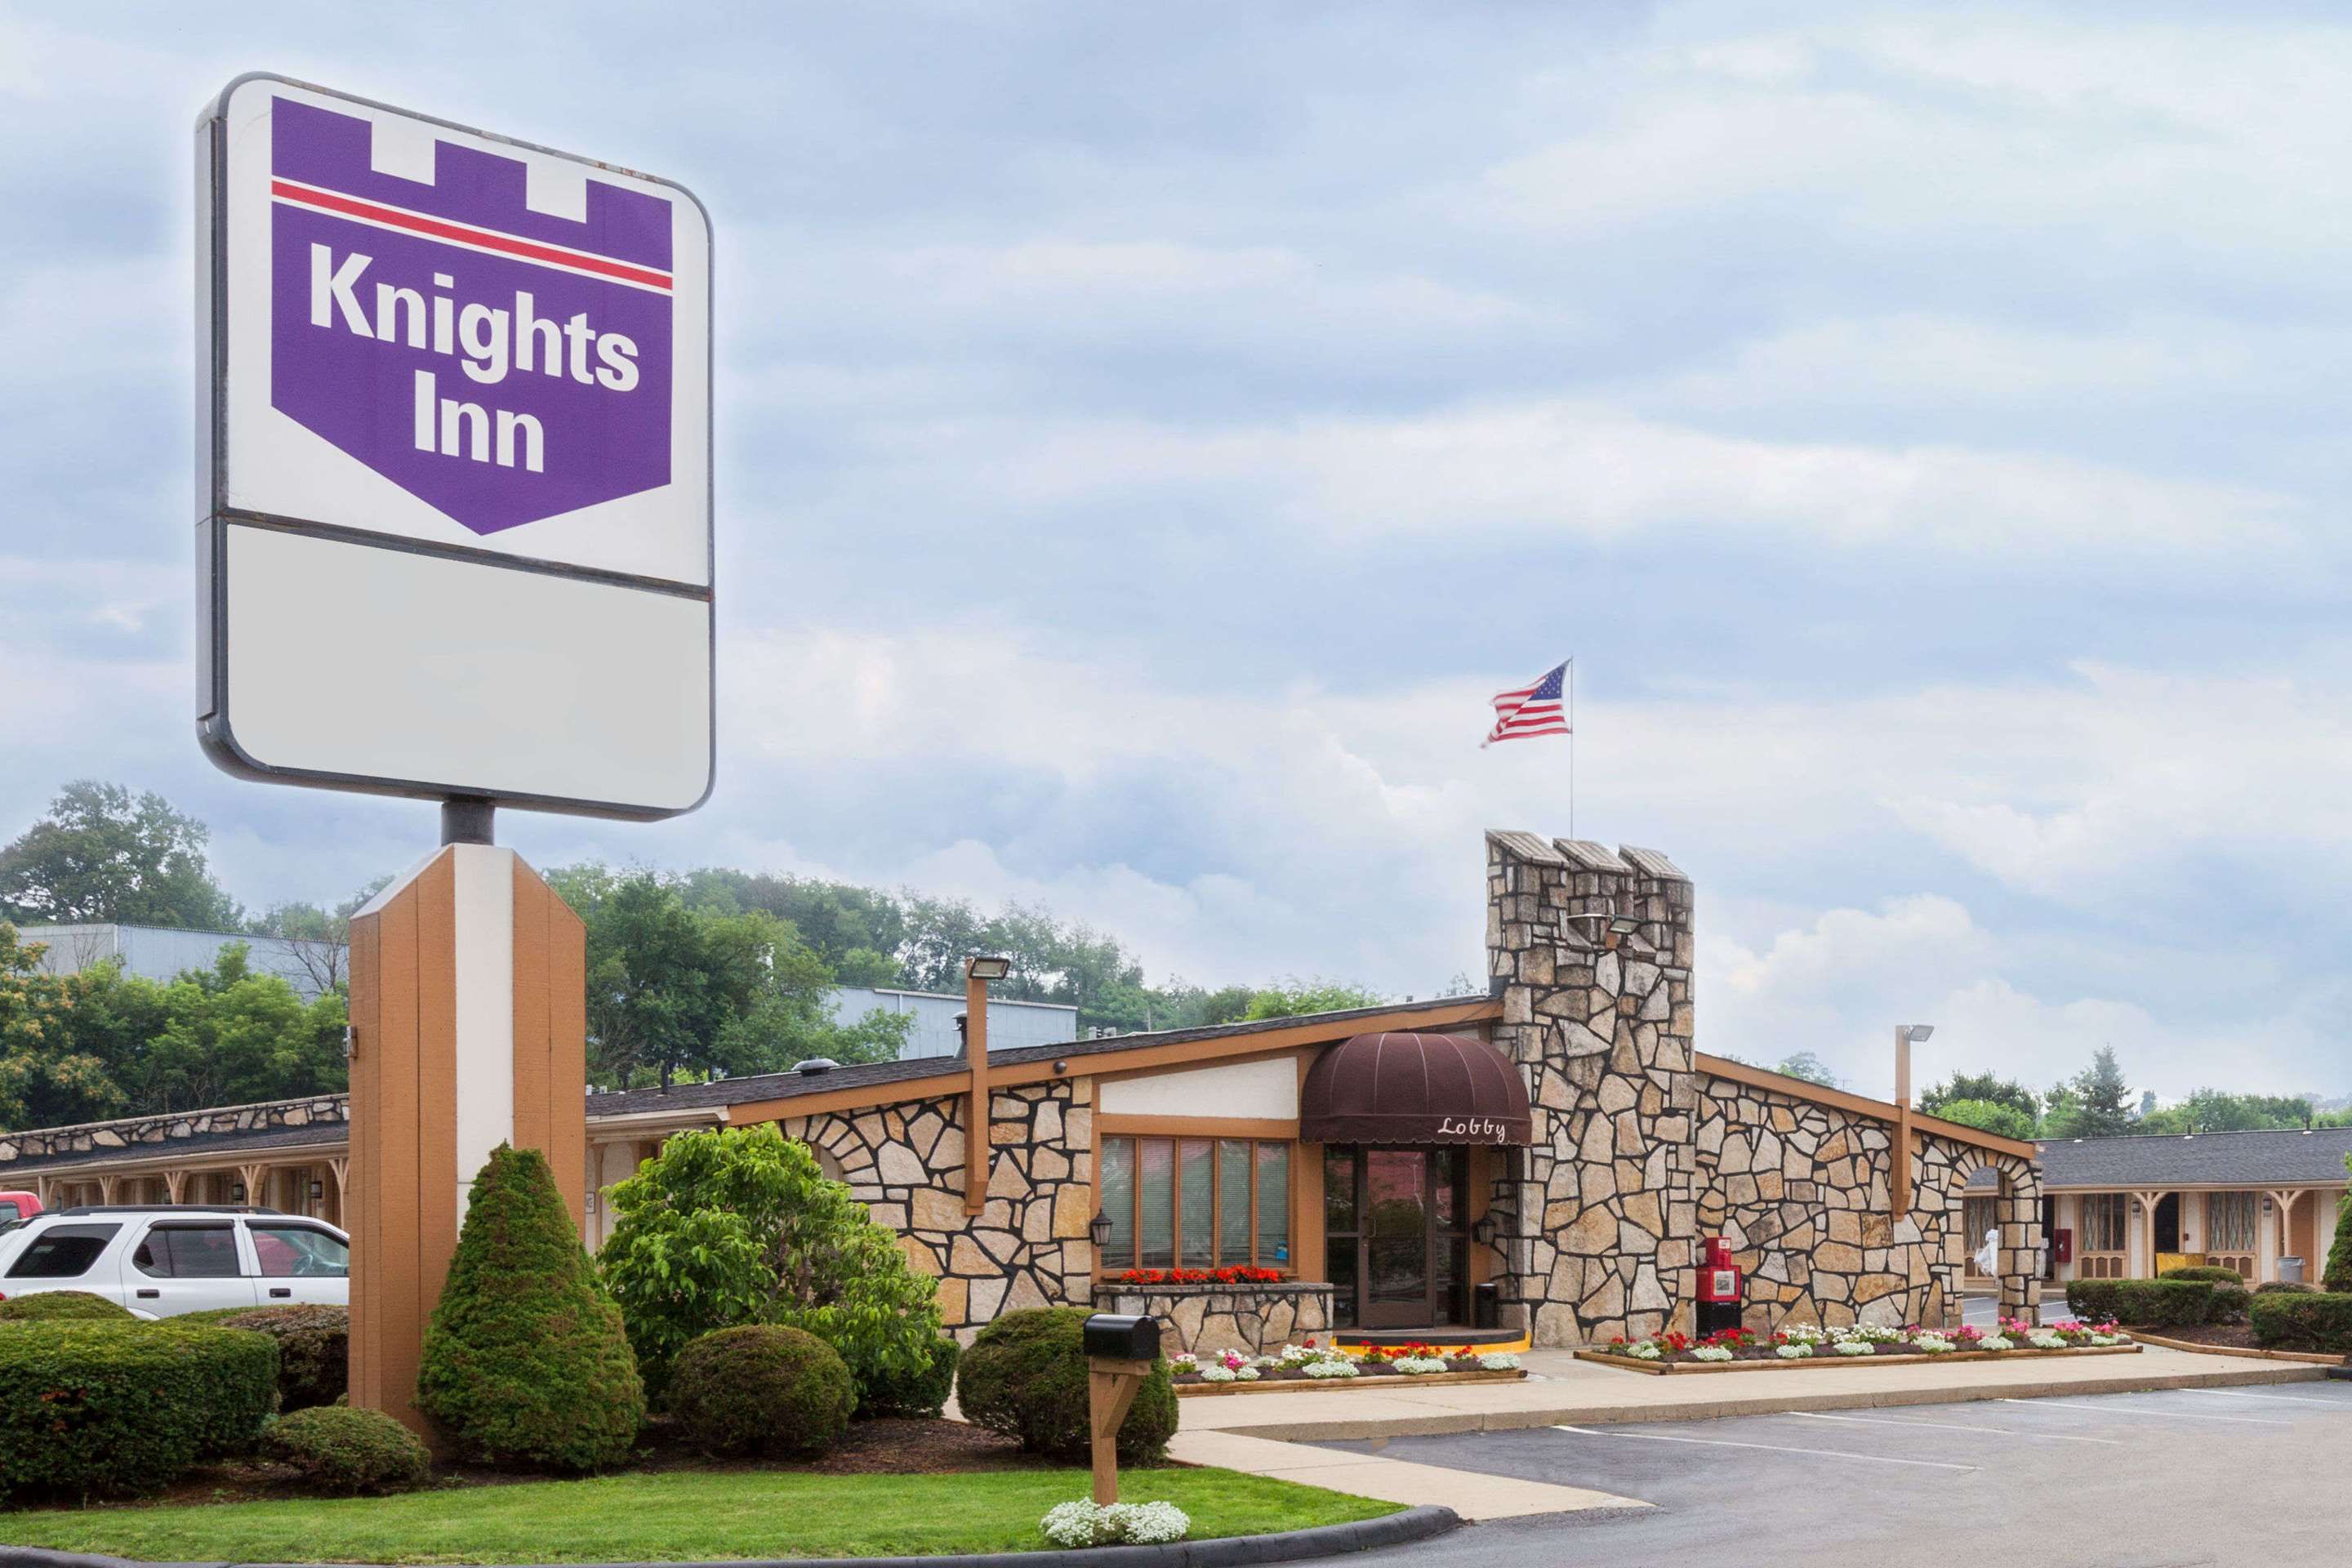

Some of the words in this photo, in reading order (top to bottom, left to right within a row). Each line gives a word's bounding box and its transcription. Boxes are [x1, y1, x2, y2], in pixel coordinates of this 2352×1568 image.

[310, 242, 639, 392] Knights
[415, 370, 544, 473] Inn
[1437, 1117, 1505, 1143] Lobby
